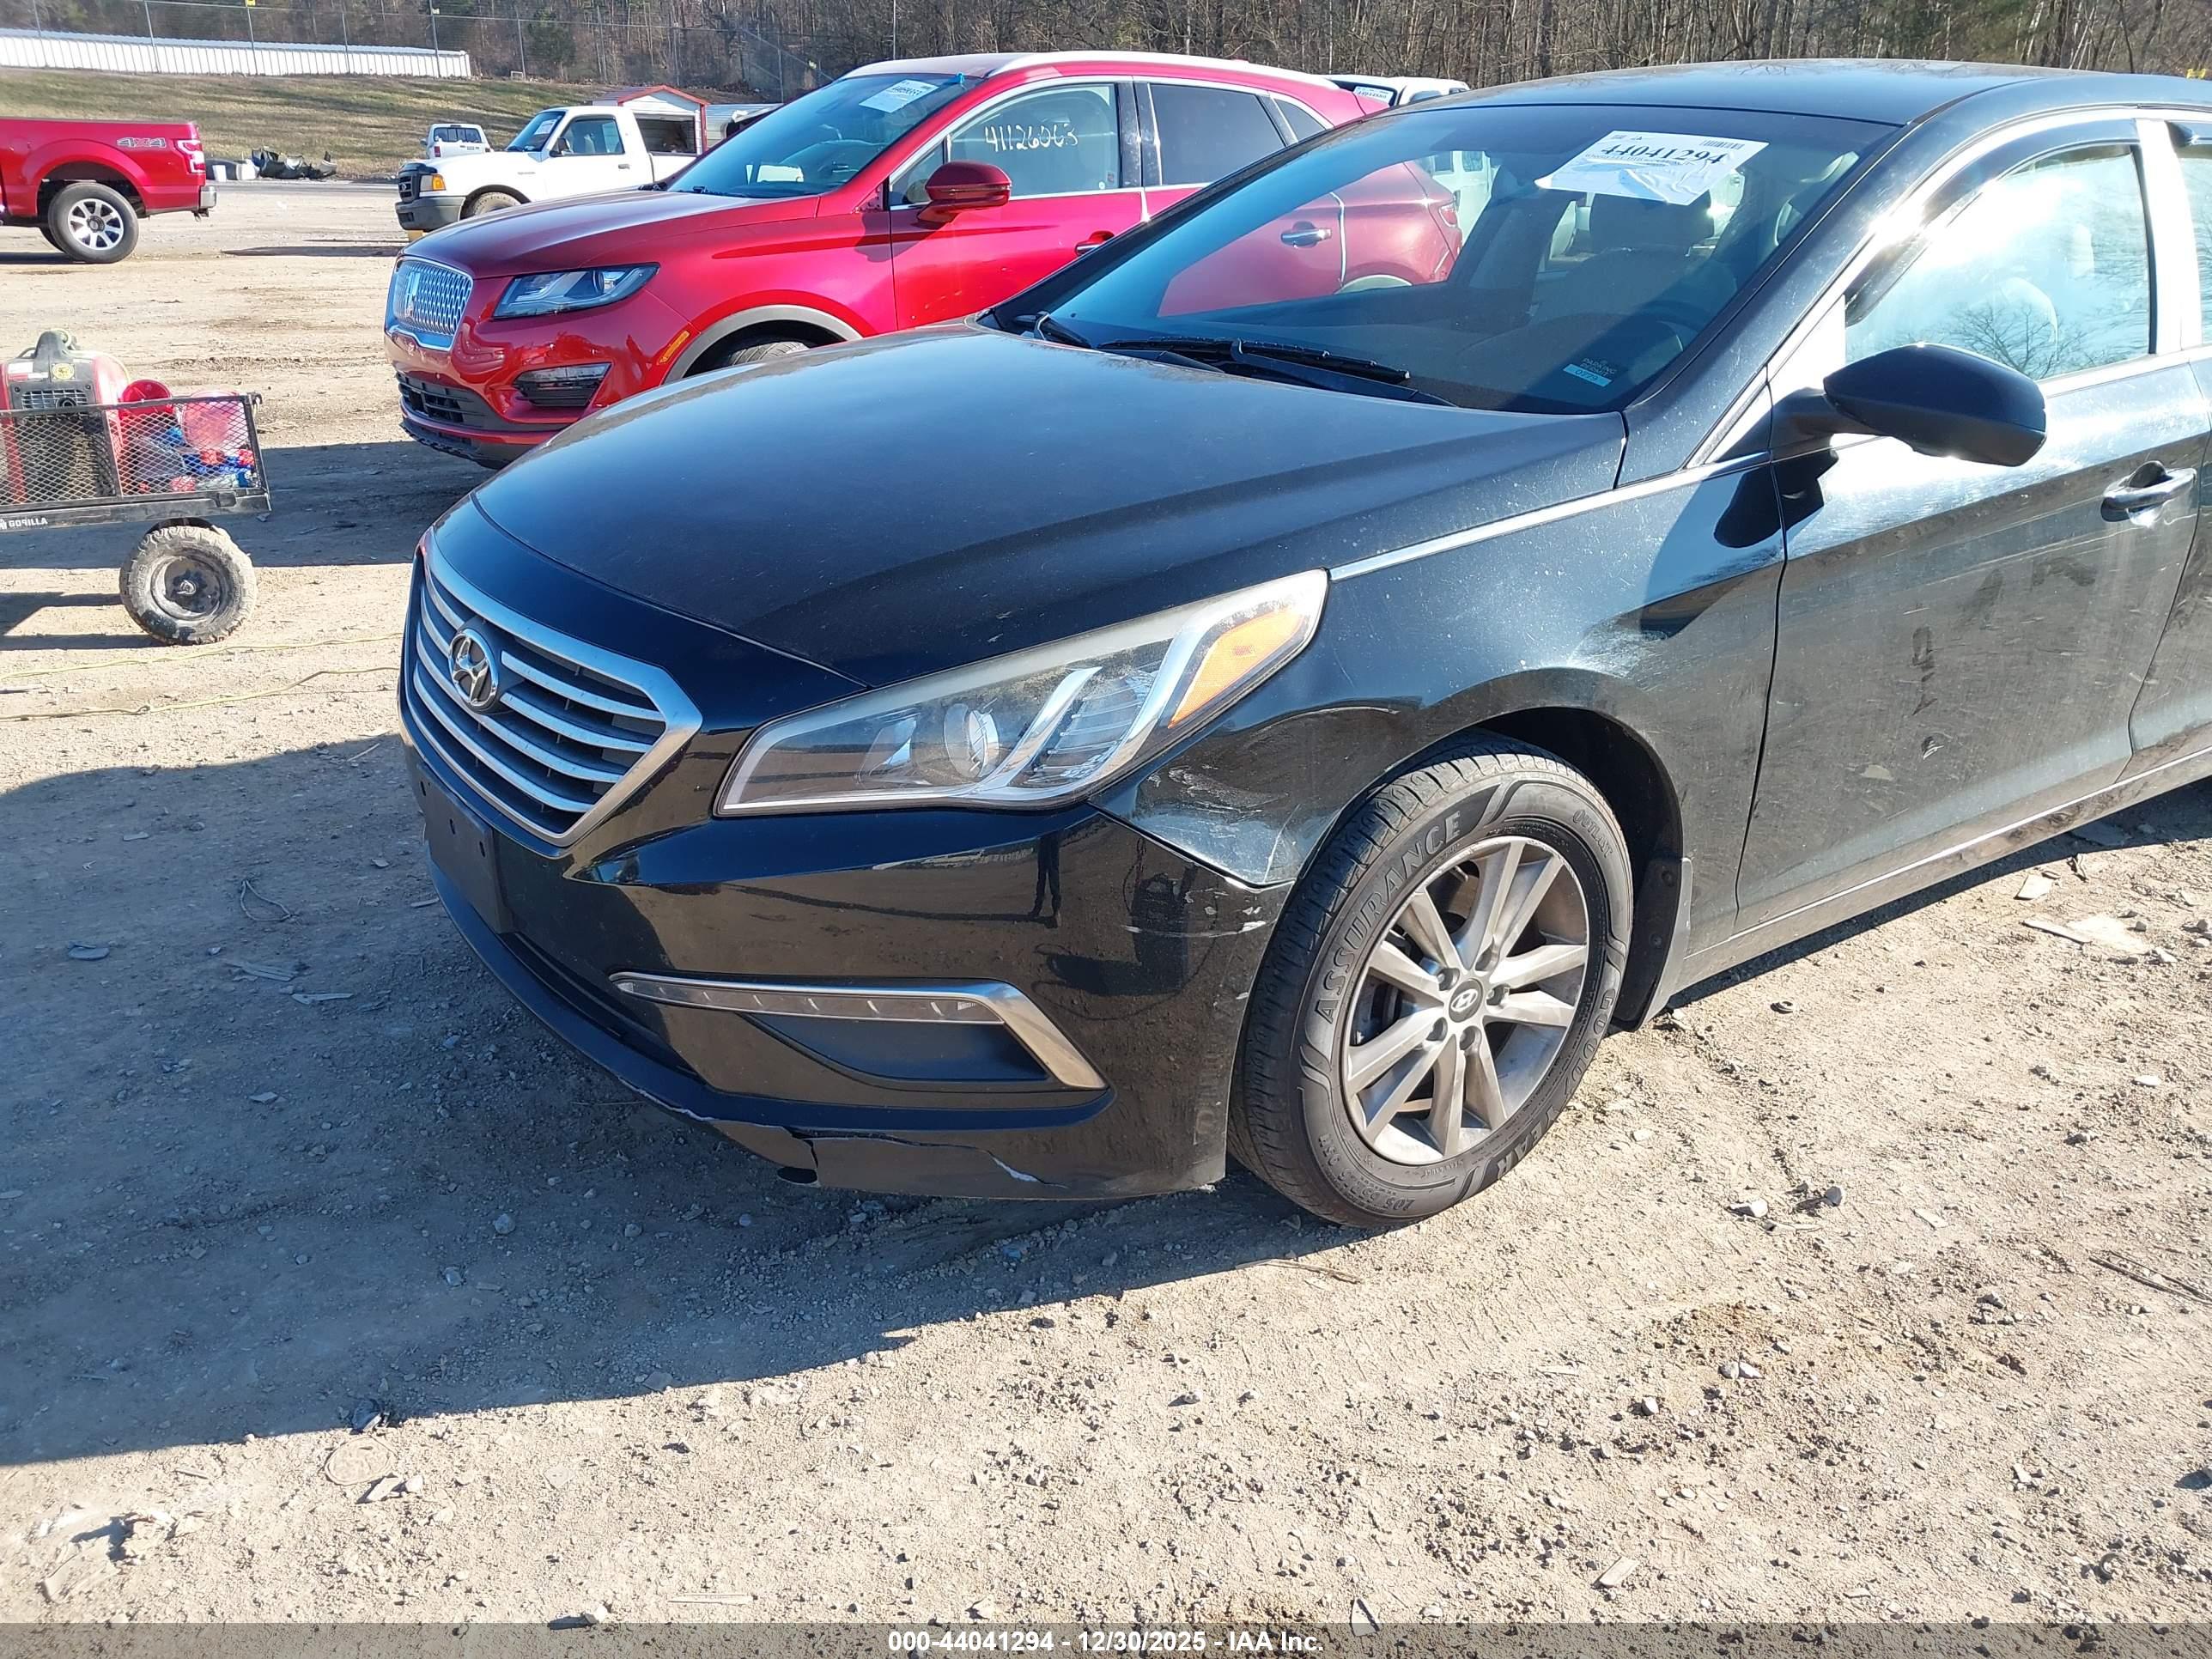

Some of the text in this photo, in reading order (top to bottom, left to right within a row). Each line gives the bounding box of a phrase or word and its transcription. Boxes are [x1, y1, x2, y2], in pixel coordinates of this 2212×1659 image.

[985, 124, 1079, 152] 41126063
[1601, 143, 1729, 164] 44041294
[9, 517, 48, 527] GORILLA
[1315, 810, 1462, 1024] ASSURANCE
